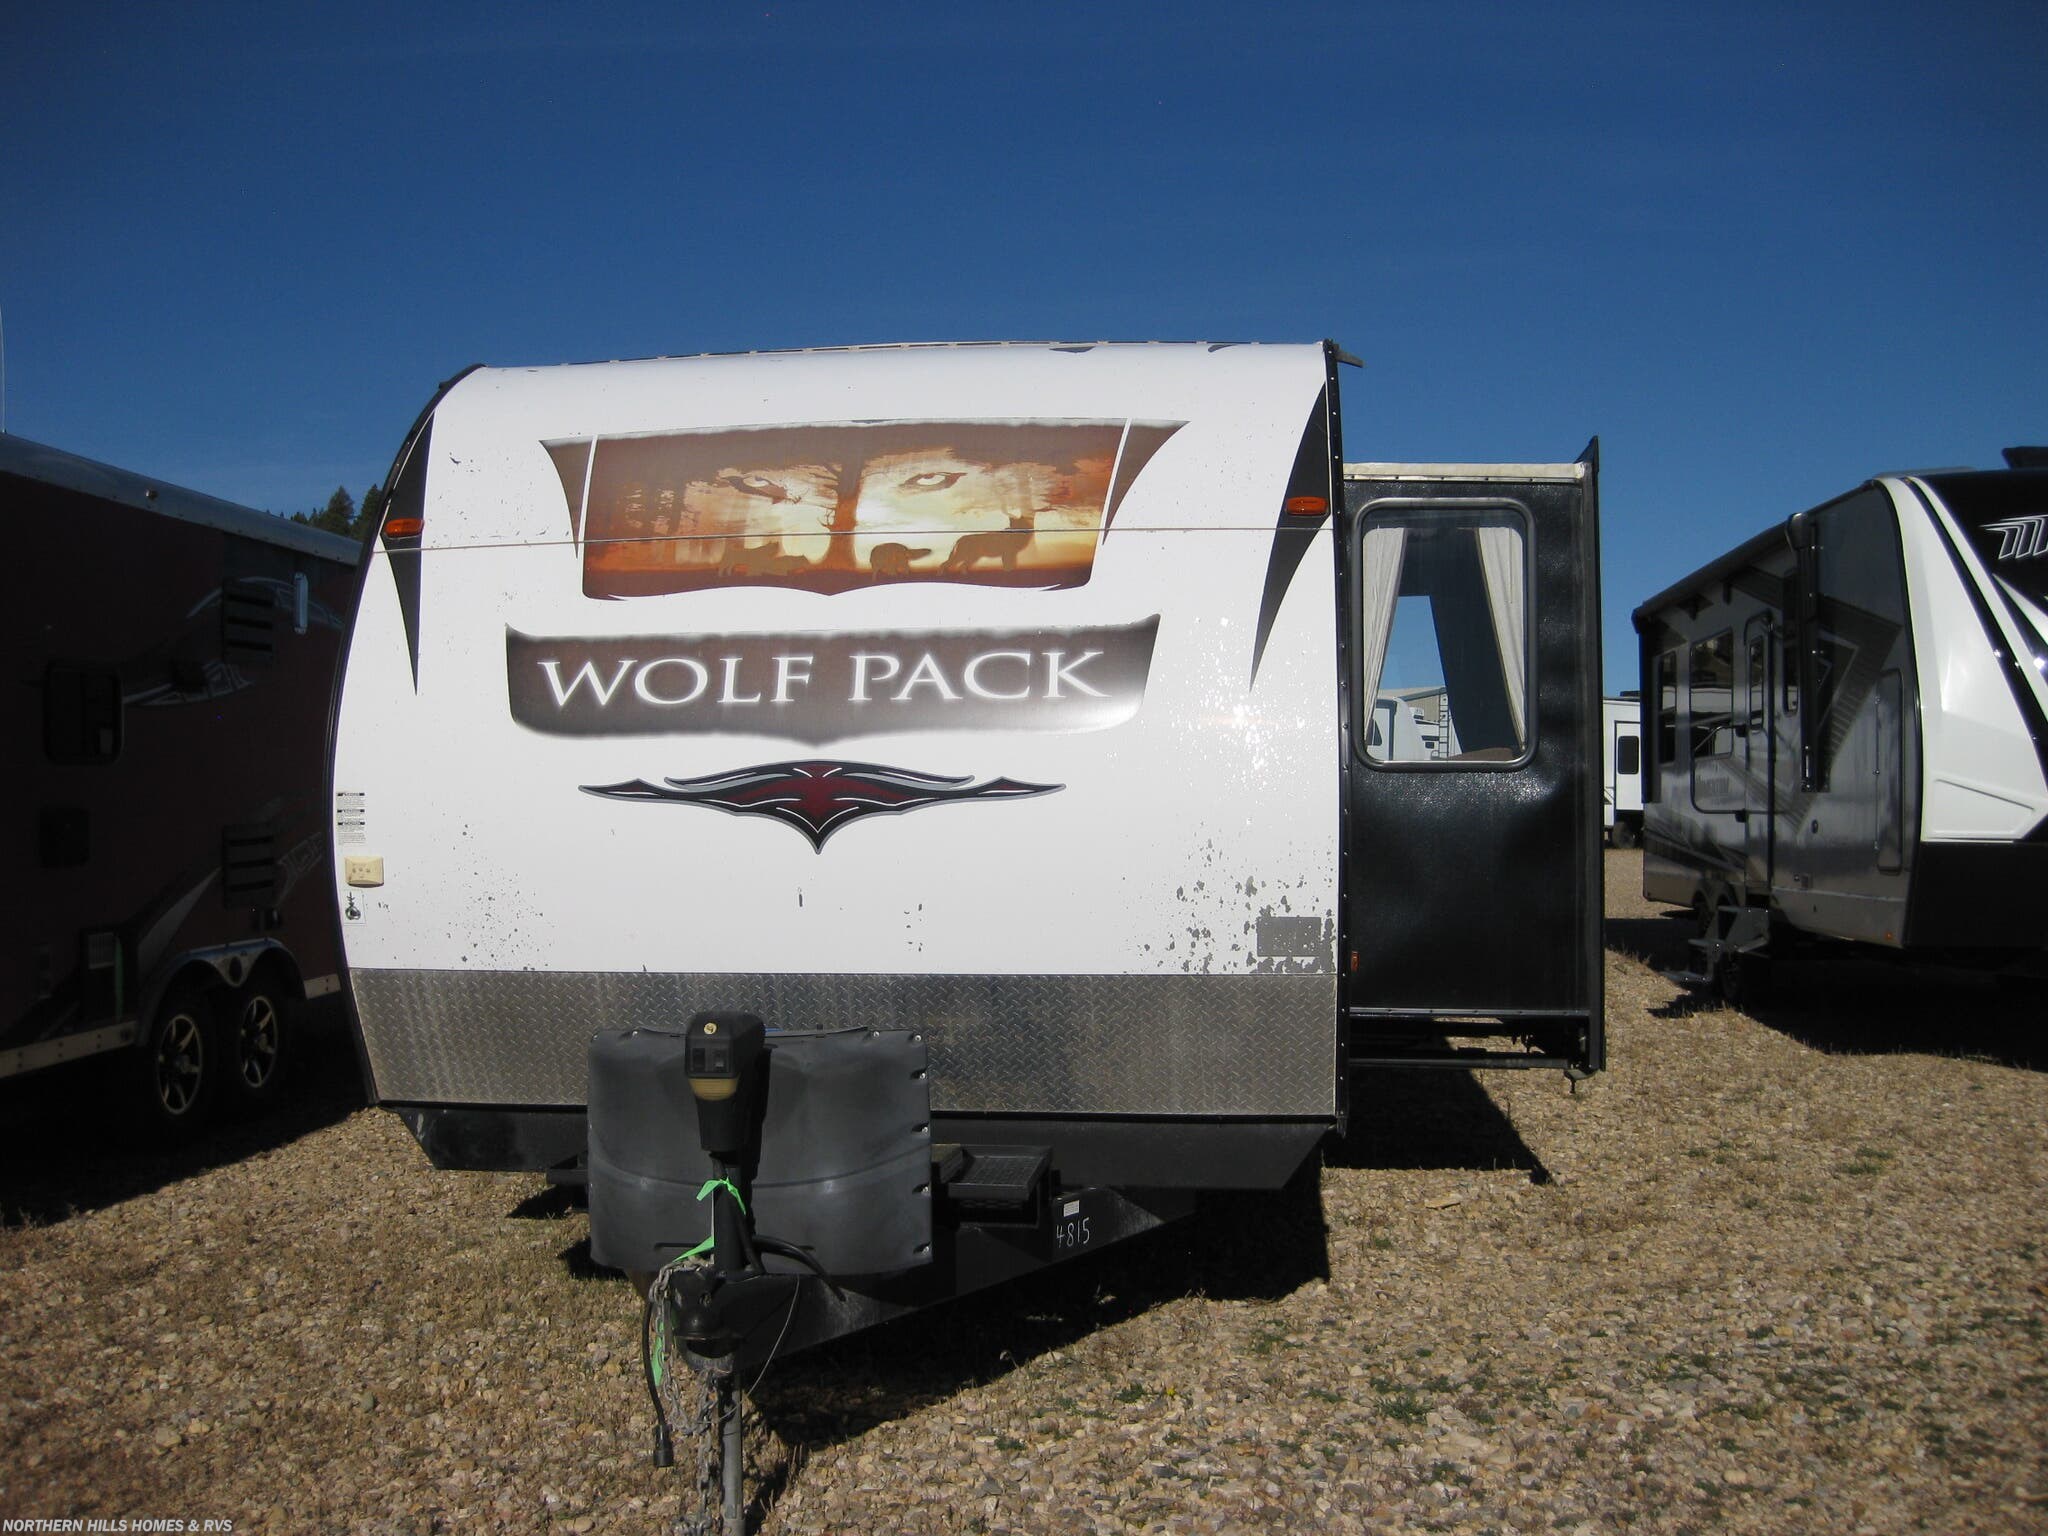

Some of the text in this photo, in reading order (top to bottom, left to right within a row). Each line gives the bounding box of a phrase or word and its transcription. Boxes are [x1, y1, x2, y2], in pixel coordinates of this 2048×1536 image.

[537, 650, 1113, 706] WOLF PACK
[1056, 1217, 1090, 1248] 4815
